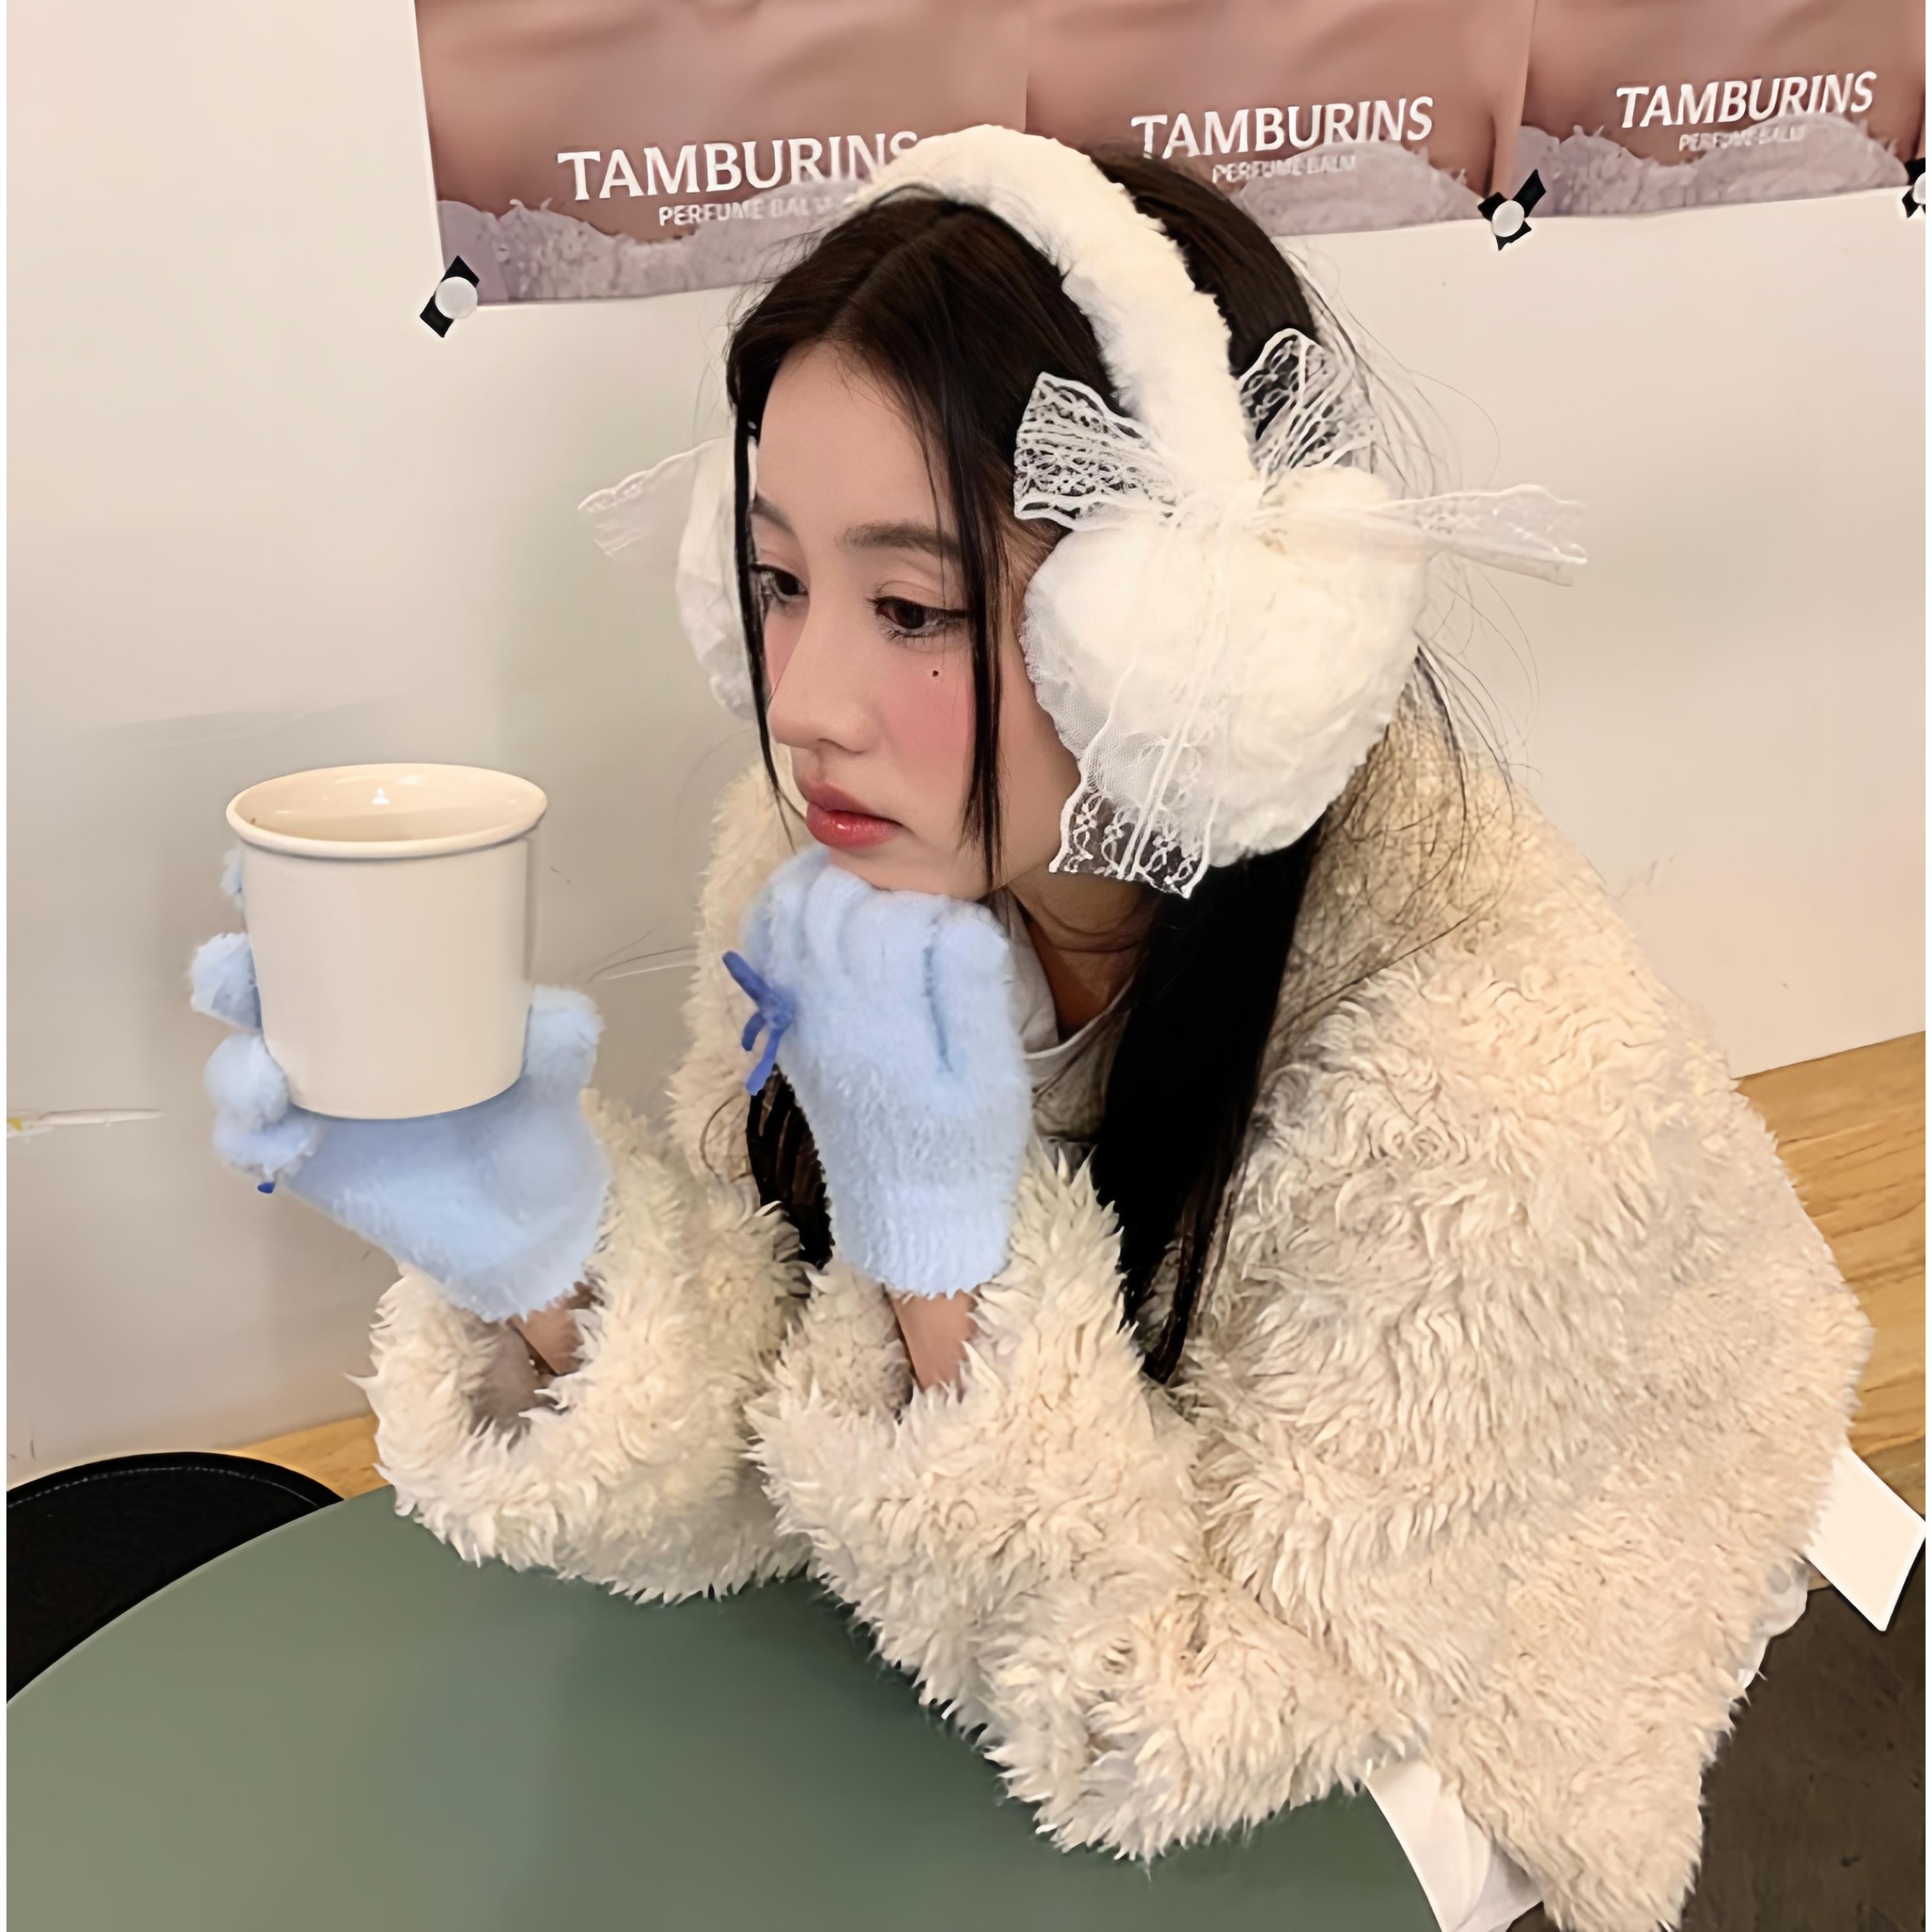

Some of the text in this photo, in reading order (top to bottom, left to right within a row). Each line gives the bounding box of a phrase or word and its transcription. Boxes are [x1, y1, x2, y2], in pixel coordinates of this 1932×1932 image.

[1131, 96, 1434, 159] TAMBURINS
[1616, 70, 1877, 128] TAMBURINS
[659, 198, 765, 226] PERFUME
